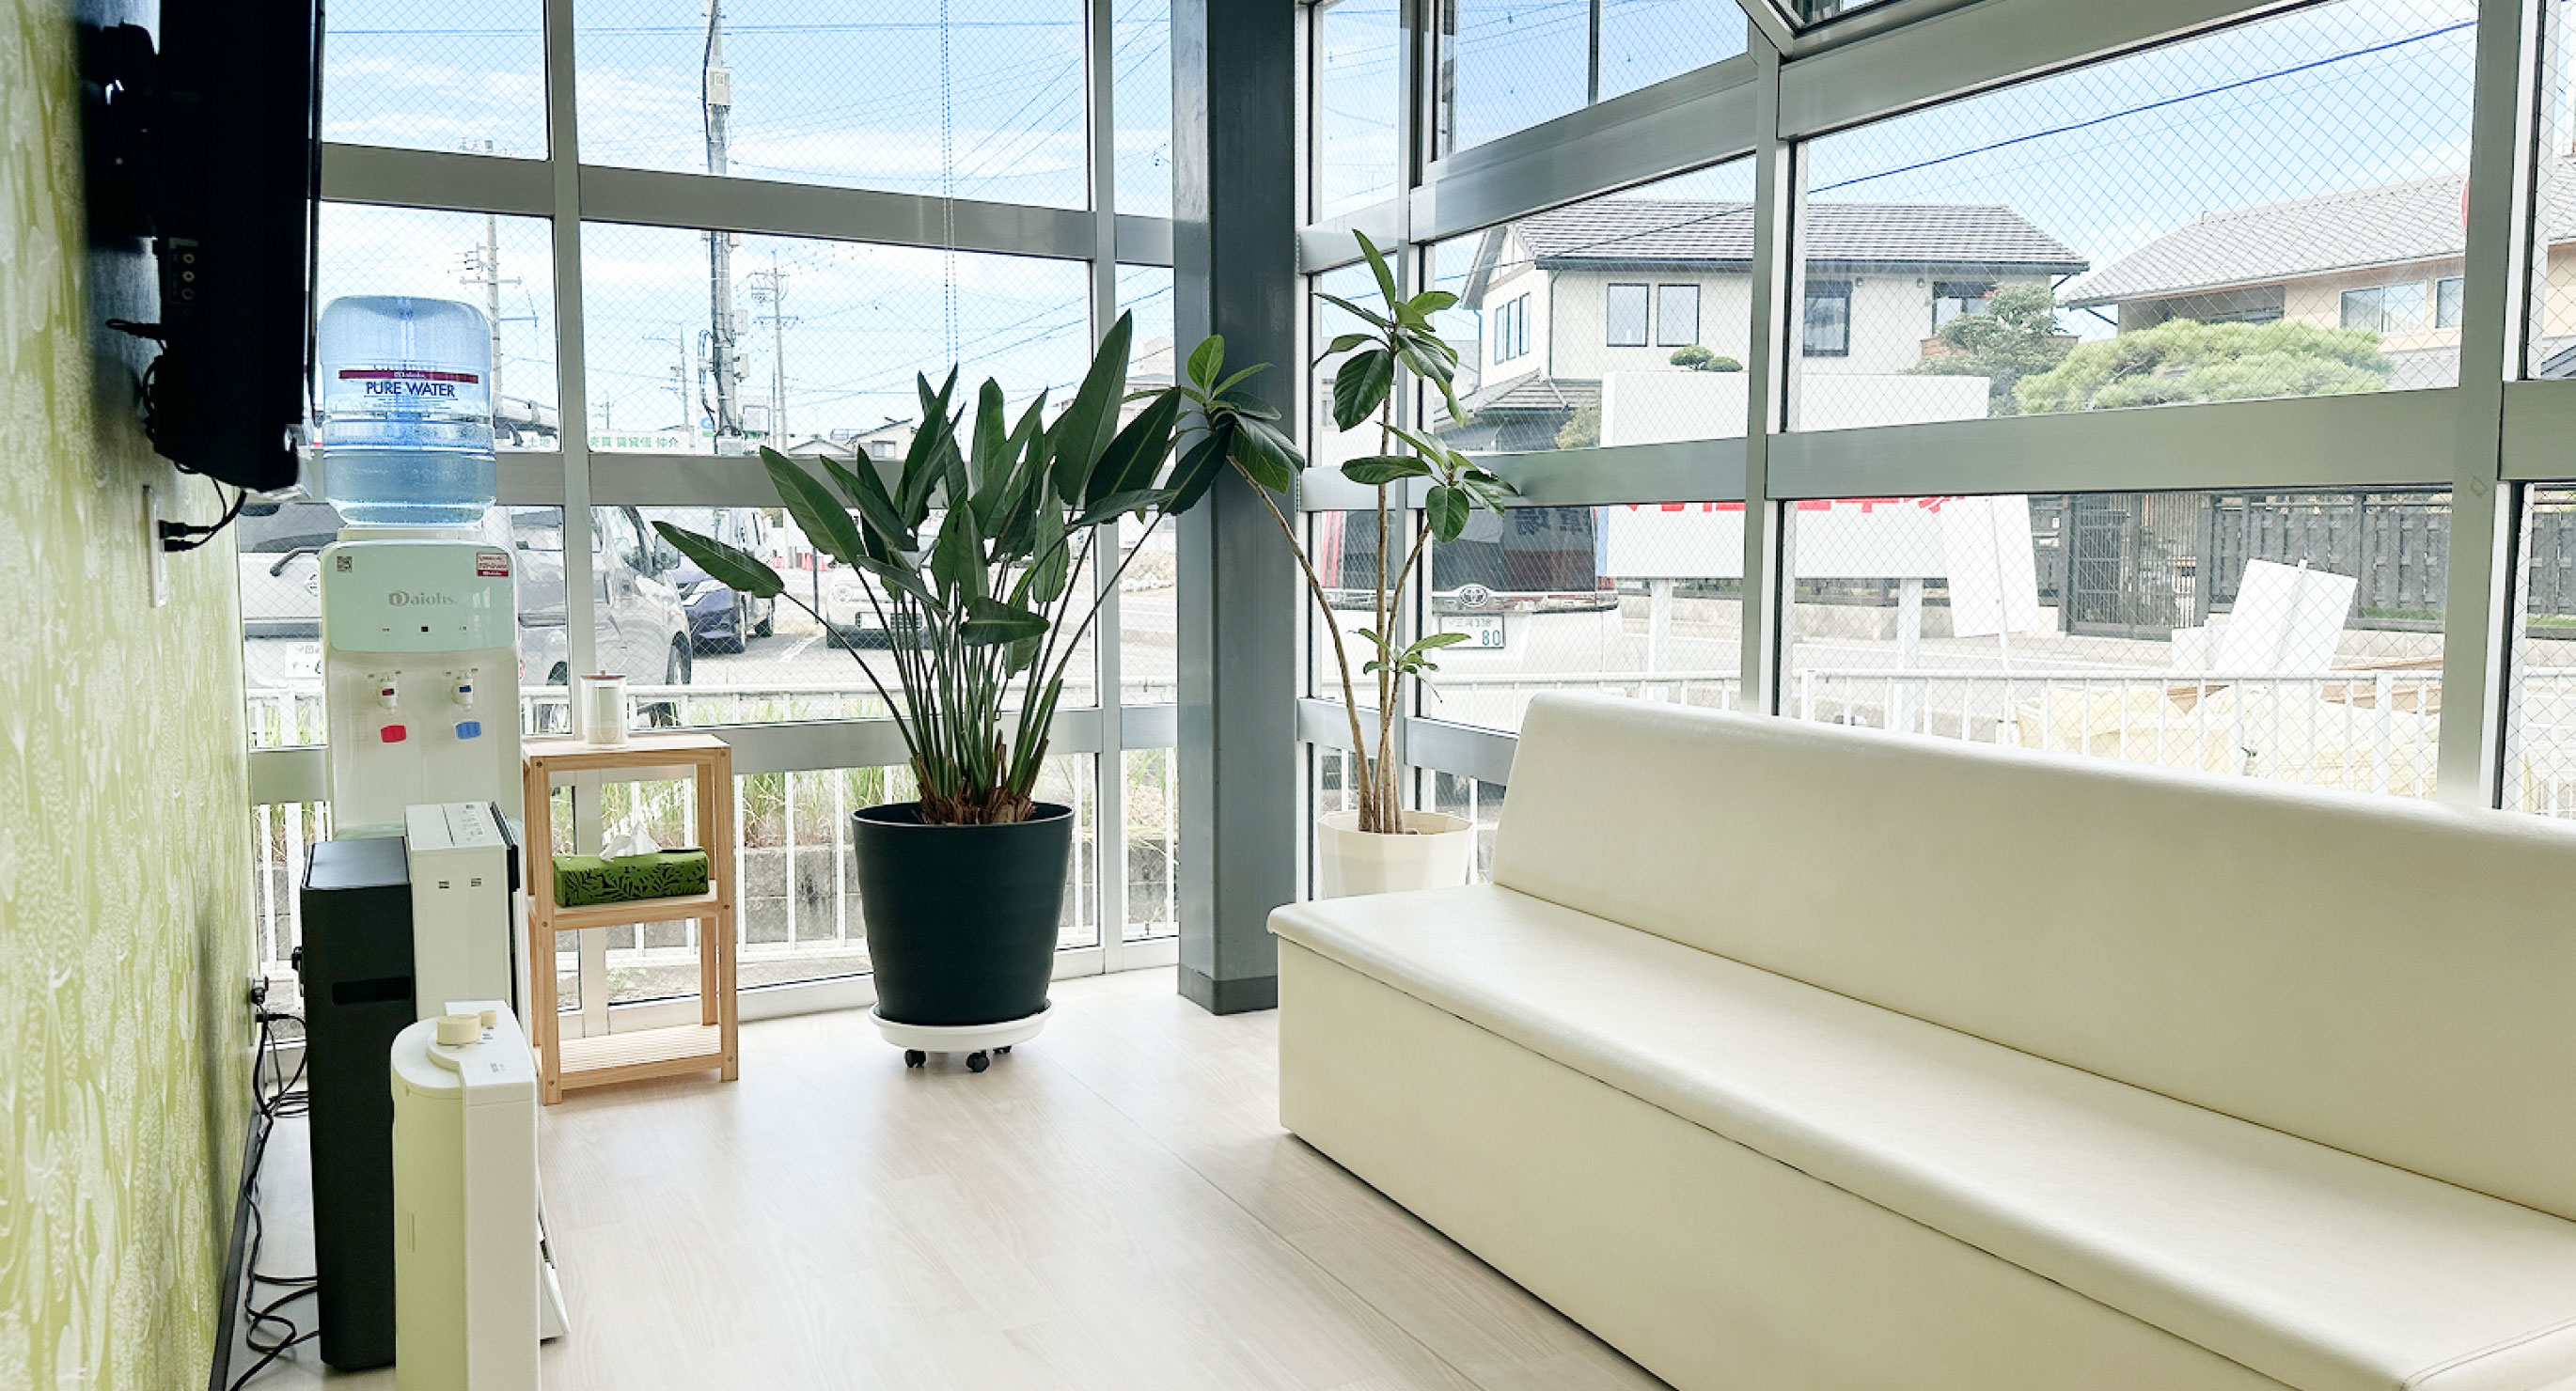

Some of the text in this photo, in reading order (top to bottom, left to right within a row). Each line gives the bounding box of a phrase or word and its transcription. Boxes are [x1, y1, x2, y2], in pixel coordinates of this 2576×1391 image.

[366, 381, 456, 398] PURE WATER
[388, 590, 455, 607] Daiohs
